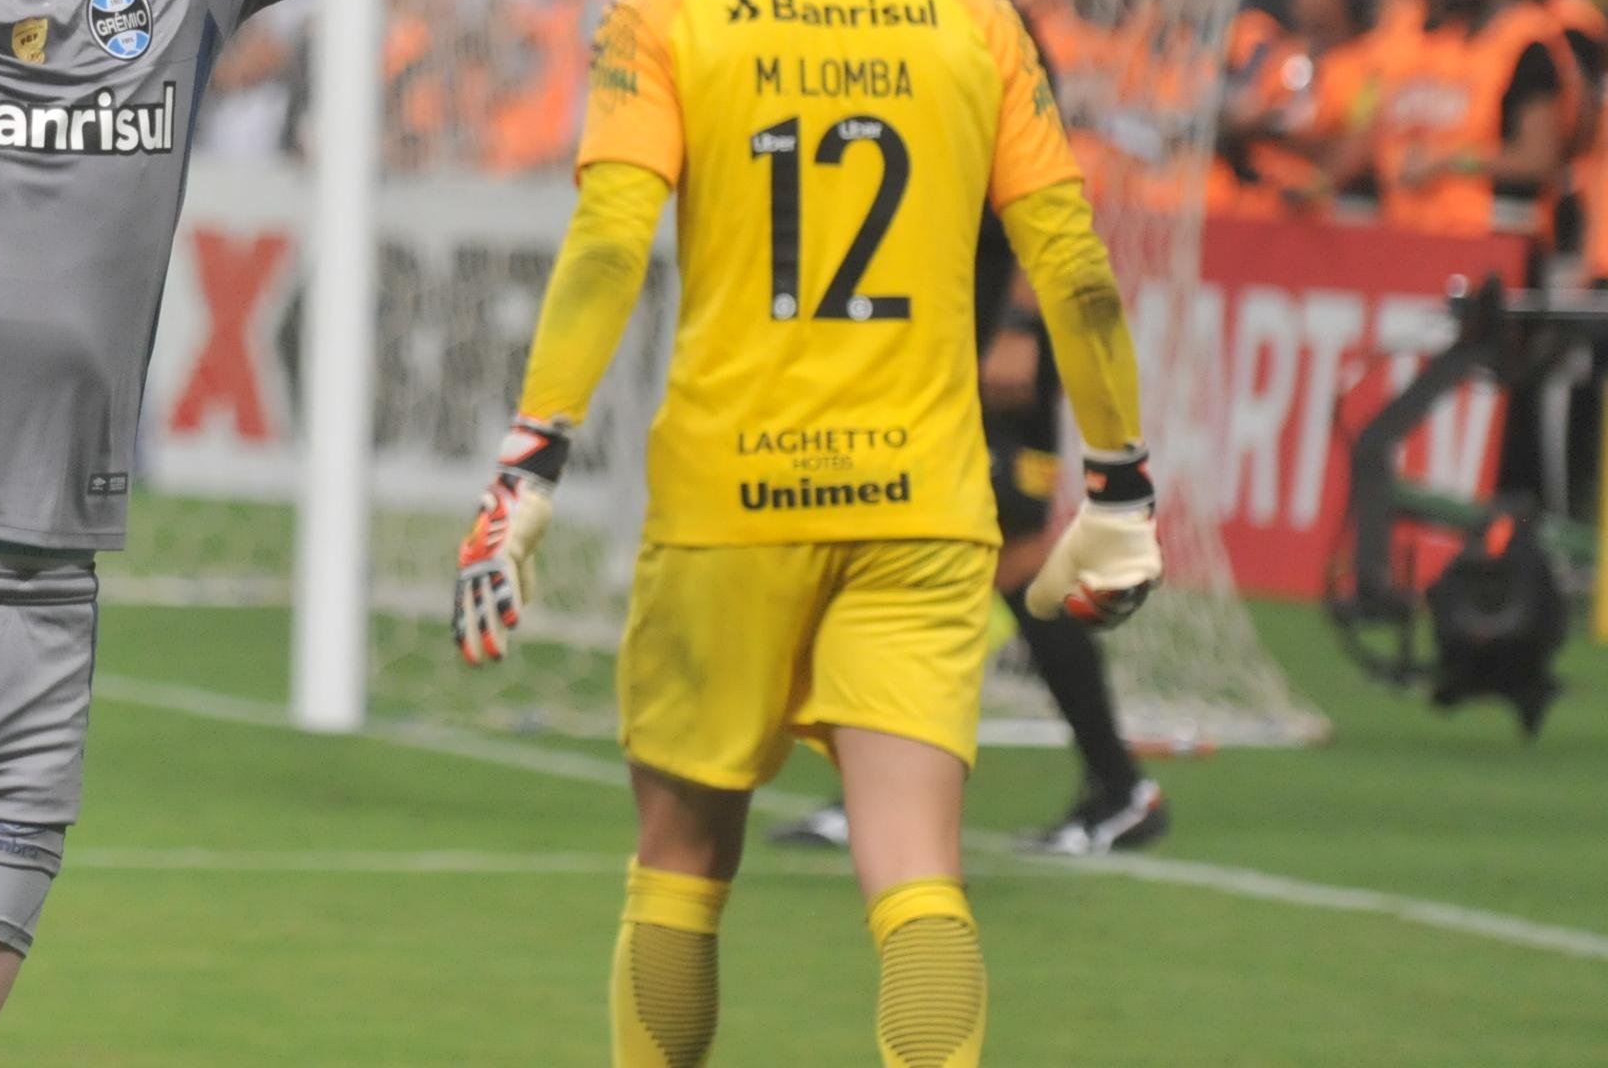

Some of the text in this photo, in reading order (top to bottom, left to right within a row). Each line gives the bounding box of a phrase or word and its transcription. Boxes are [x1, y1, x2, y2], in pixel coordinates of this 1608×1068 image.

[96, 10, 147, 37] GRÊMIO
[799, 59, 913, 98] LOMBA
[750, 115, 911, 320] 12
[739, 428, 908, 456] LAGHETTO
[740, 473, 911, 511] Unimed
